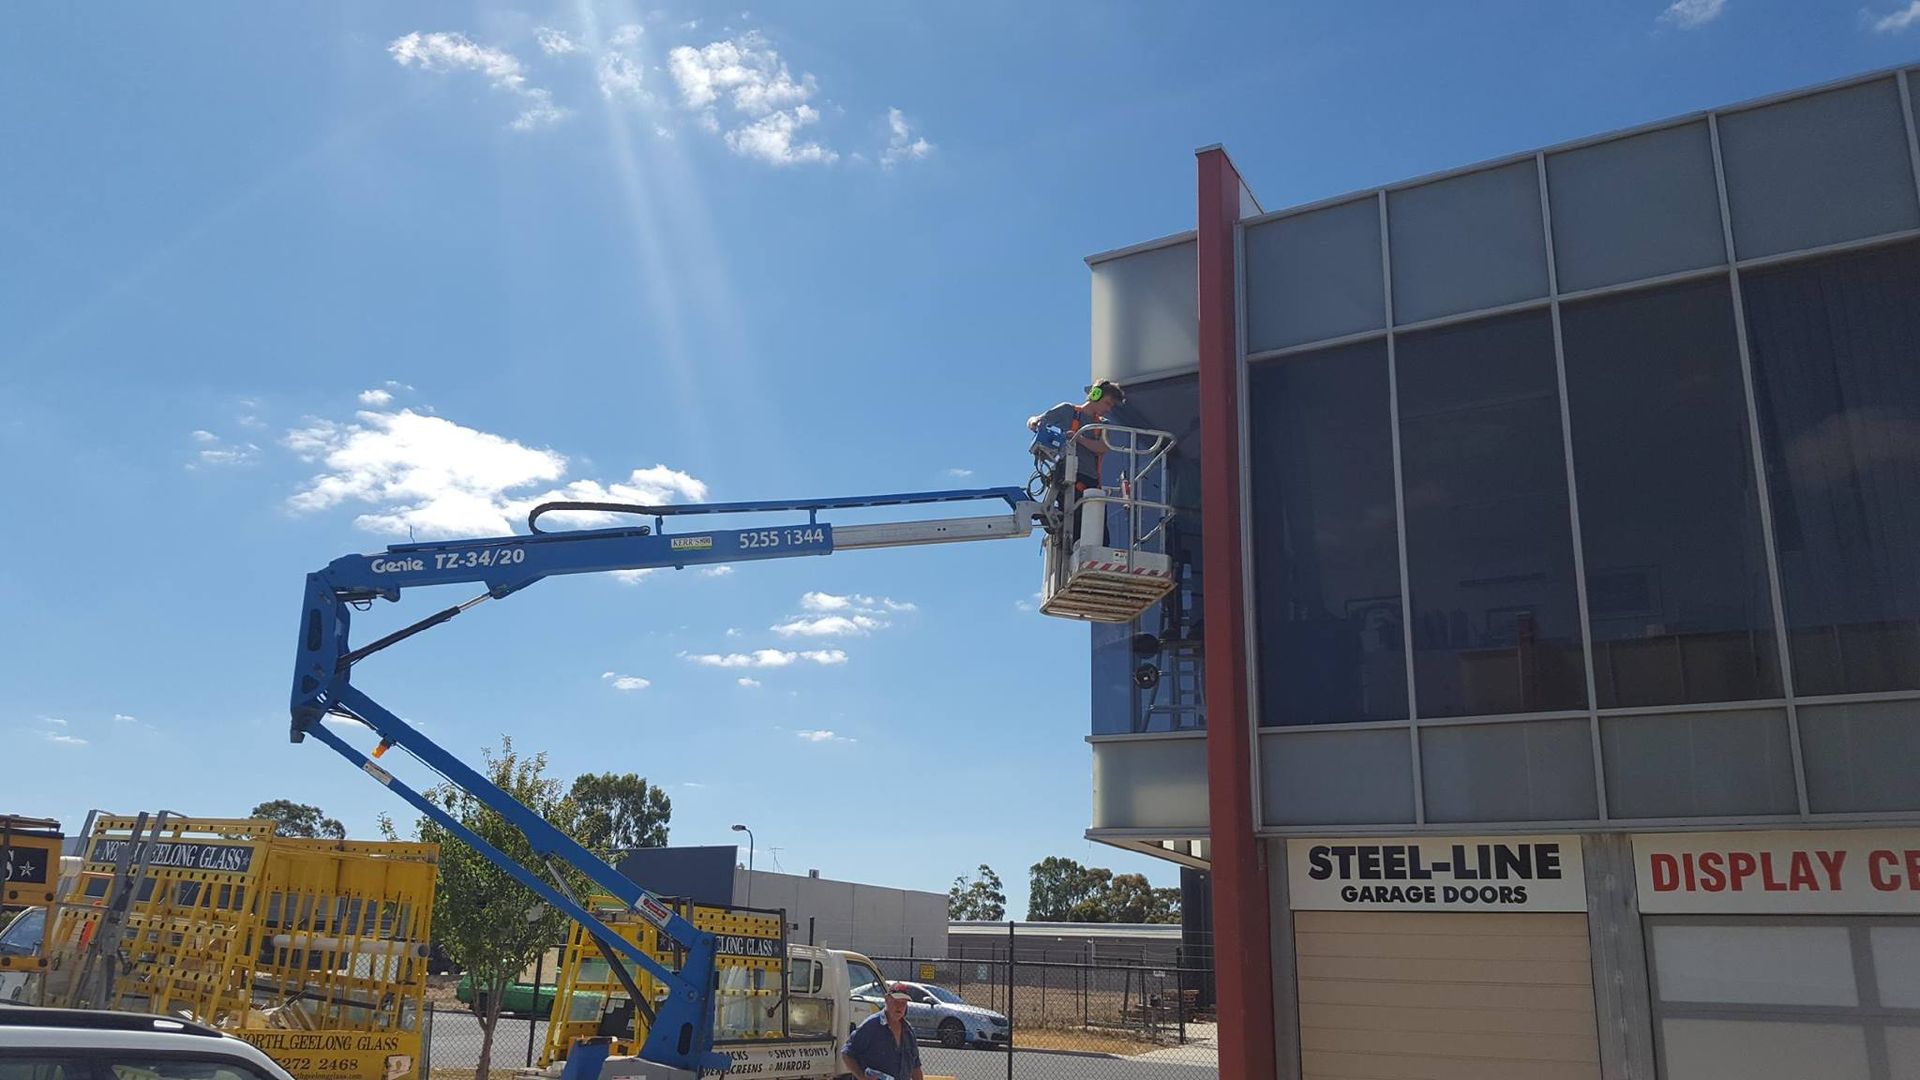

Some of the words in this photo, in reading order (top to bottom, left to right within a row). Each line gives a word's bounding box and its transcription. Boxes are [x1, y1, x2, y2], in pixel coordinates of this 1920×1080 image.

[740, 530, 780, 549] 5255
[784, 528, 824, 546] 1344
[371, 557, 424, 574] Genie
[435, 548, 525, 570] TZ-34/20
[200, 846, 245, 871] GLASS
[1308, 843, 1562, 880] STEEL-LINE
[1650, 850, 1847, 892] DISPLAY
[1341, 885, 1437, 903] GARAGE
[1443, 885, 1528, 904] DOORS
[746, 938, 774, 958] GLASS
[289, 1033, 351, 1050] GEELONG
[357, 1036, 399, 1050] GLASS
[774, 1047, 797, 1059] SHOP
[799, 1047, 829, 1058] FRONTS
[277, 1057, 311, 1070] 272
[318, 1058, 359, 1071] 2468
[774, 1060, 811, 1072] MIRRORS
